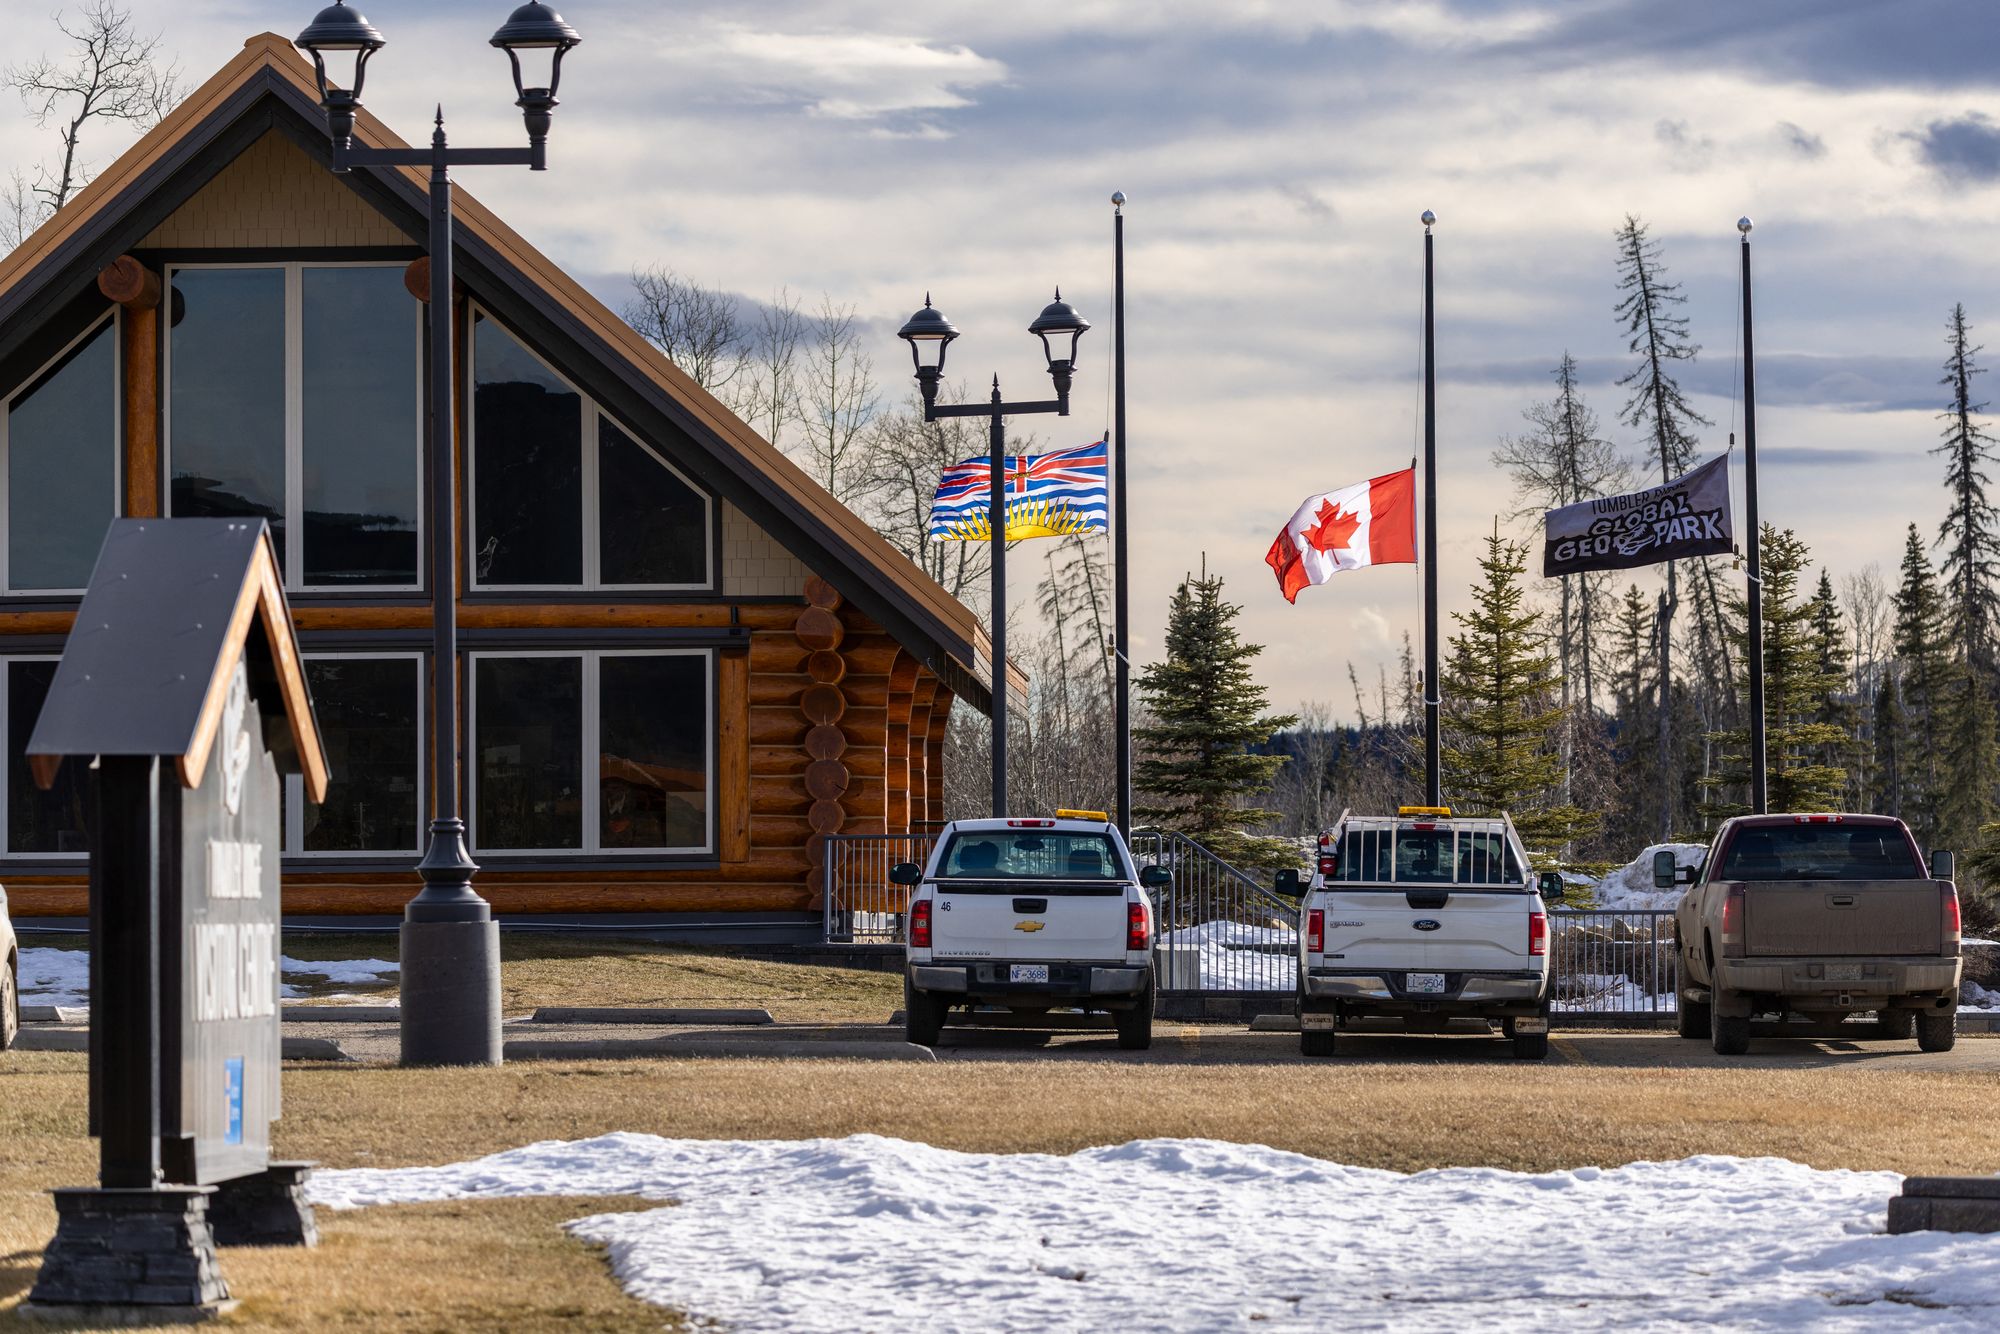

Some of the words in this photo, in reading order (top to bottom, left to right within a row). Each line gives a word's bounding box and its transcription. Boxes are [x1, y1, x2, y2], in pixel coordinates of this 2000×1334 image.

[1590, 494, 1690, 536] GLOBAL
[1591, 490, 1650, 515] TUMBLER
[941, 901, 952, 912] 46
